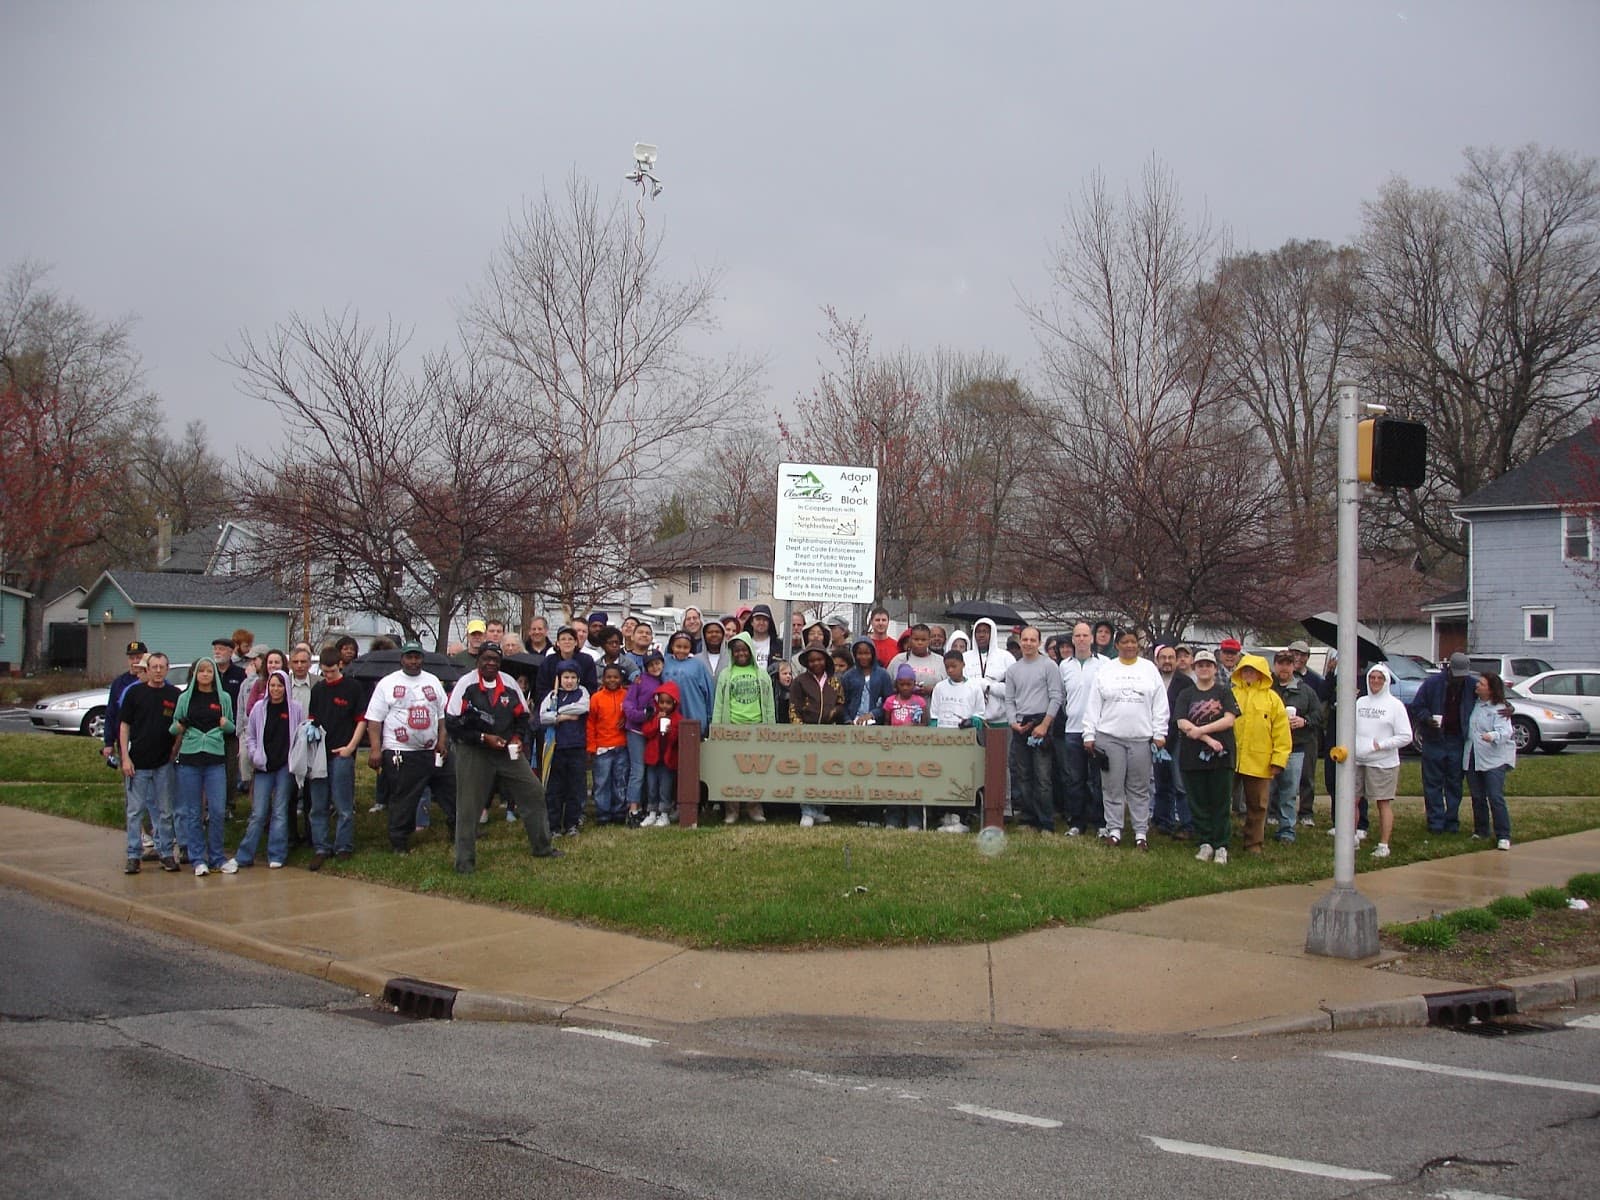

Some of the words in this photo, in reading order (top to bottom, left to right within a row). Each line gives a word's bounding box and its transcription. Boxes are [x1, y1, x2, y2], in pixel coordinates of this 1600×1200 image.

[840, 472, 871, 481] Adopt
[841, 496, 868, 505] Block
[711, 728, 751, 742] Near
[756, 729, 846, 744] Northwest
[851, 730, 975, 750] Neighborhood
[735, 753, 942, 777] Welcome
[722, 786, 764, 799] City
[773, 787, 795, 798] of
[805, 785, 864, 799] South
[869, 789, 922, 800] Bend
